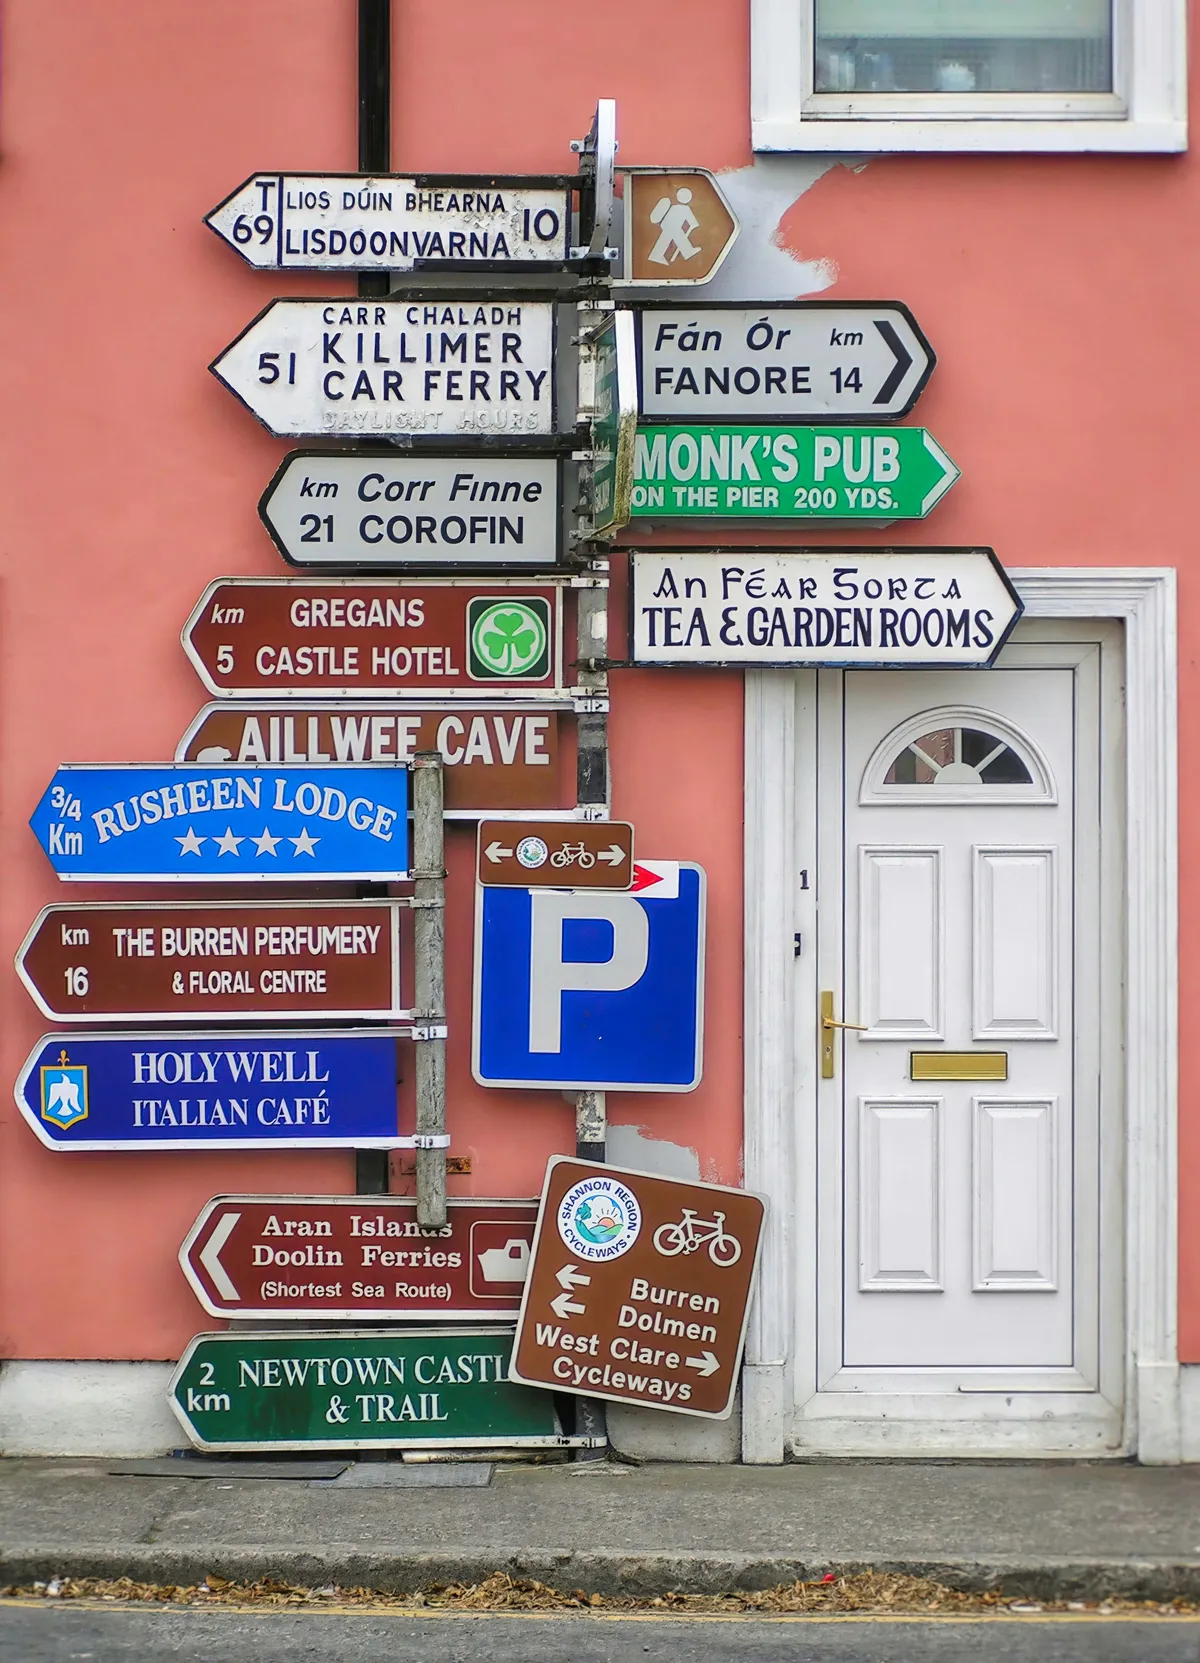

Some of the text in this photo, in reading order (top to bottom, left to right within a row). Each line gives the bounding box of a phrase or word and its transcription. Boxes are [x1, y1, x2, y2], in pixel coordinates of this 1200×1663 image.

[255, 181, 276, 210] T
[286, 187, 506, 213] LIOS DÚIN BHEARNA
[232, 215, 274, 245] 69
[522, 209, 559, 242] 10
[286, 230, 511, 258] LISDOONVARNA
[323, 307, 522, 326] CARR CHALADH
[323, 332, 523, 364] KILLIMER
[653, 316, 791, 352] Fán Ór
[830, 328, 864, 347] km
[258, 352, 296, 385] 51
[654, 366, 812, 395] FANORE
[830, 367, 863, 394] 14
[323, 369, 548, 401] CAR FERRY
[322, 410, 540, 430] DAYLIGHT HOURS
[814, 436, 901, 483] PUB
[300, 476, 339, 498] km
[357, 473, 436, 502] Corr
[632, 487, 899, 510] ON THE PIER 200 YDS.
[300, 515, 335, 543] 21
[359, 515, 524, 544] COROFIN
[652, 568, 707, 600] An
[210, 603, 245, 624] km
[290, 599, 425, 628] GREGANS
[642, 607, 712, 647] TEA
[746, 607, 873, 648] GARDEN
[880, 608, 995, 648] ROOMS
[216, 646, 235, 674] 5
[256, 646, 460, 677] CASTLE HOTEL
[238, 715, 550, 766] AILLWEE CAVE
[91, 776, 398, 844] RUSHEEN LODGE
[49, 823, 83, 855] Km
[61, 924, 89, 946] km
[112, 925, 382, 957] THE BURREN PERFUMERY
[64, 966, 89, 997] 16
[172, 970, 327, 995] & FLORAL CENTRE
[529, 891, 649, 1053] P
[132, 1051, 330, 1085] HOLYWELL
[132, 1089, 330, 1128] ITALIAN CAFÉ
[561, 1180, 638, 1232] SHANNON REGION
[261, 1215, 333, 1238] Aran
[252, 1245, 462, 1269] Doolin Ferries
[563, 1228, 628, 1259] CYCLEWAYS
[260, 1281, 452, 1302] (Shortest Sea Route)
[630, 1278, 720, 1315] Burren
[618, 1305, 717, 1343] Dolmen
[535, 1323, 680, 1369] West Clare
[199, 1362, 216, 1386] 2
[238, 1354, 511, 1389] NEWTOWN CASTL
[553, 1356, 692, 1402] Cycleways
[187, 1388, 231, 1412] km
[325, 1393, 448, 1424] & TRAIL
